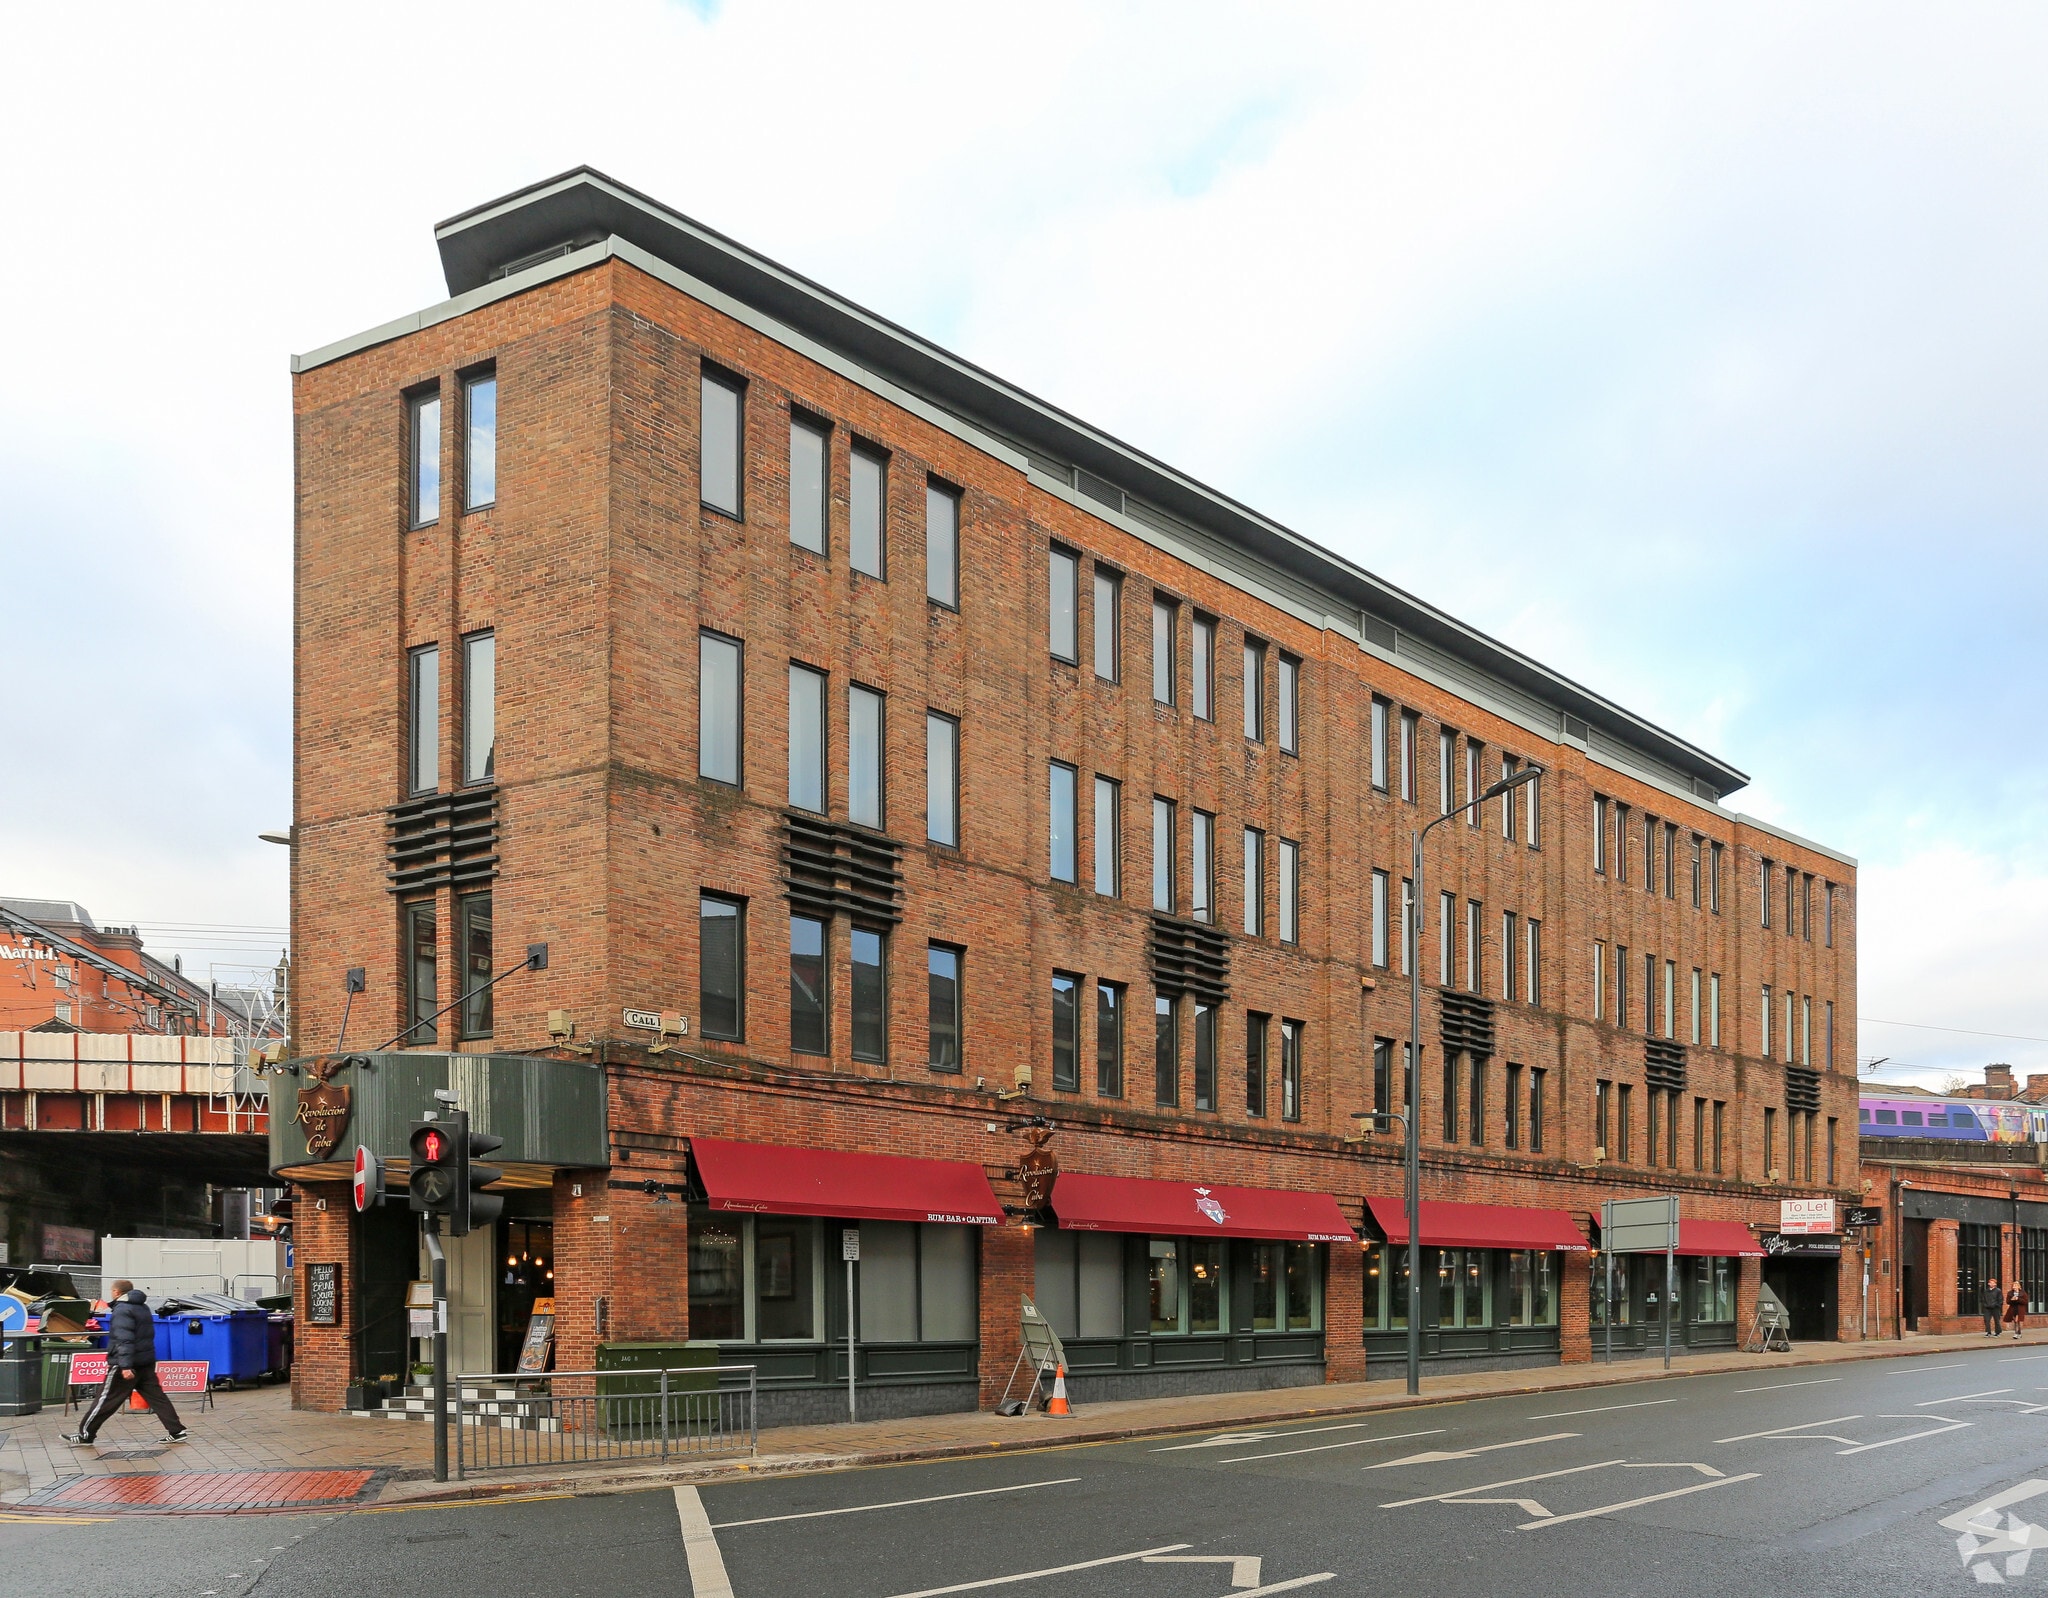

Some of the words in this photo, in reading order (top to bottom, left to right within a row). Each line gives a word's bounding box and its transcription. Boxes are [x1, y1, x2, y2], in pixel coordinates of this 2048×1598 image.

[632, 1014, 656, 1026] CALL
[288, 1102, 347, 1125] Revolución
[315, 1119, 328, 1131] de
[306, 1134, 333, 1156] Cuba
[1786, 1202, 1803, 1212] To
[1807, 1201, 1828, 1212] Let
[927, 1213, 945, 1222] RUM
[945, 1215, 962, 1223] BAR
[966, 1216, 998, 1225] CANTINA
[313, 1265, 334, 1274] HELLO
[75, 1361, 109, 1370] FOOTW
[159, 1366, 205, 1374] FOOTPATH
[78, 1368, 109, 1377] CLOS
[166, 1373, 197, 1381] AHEAD
[162, 1379, 199, 1388] CLOSED
